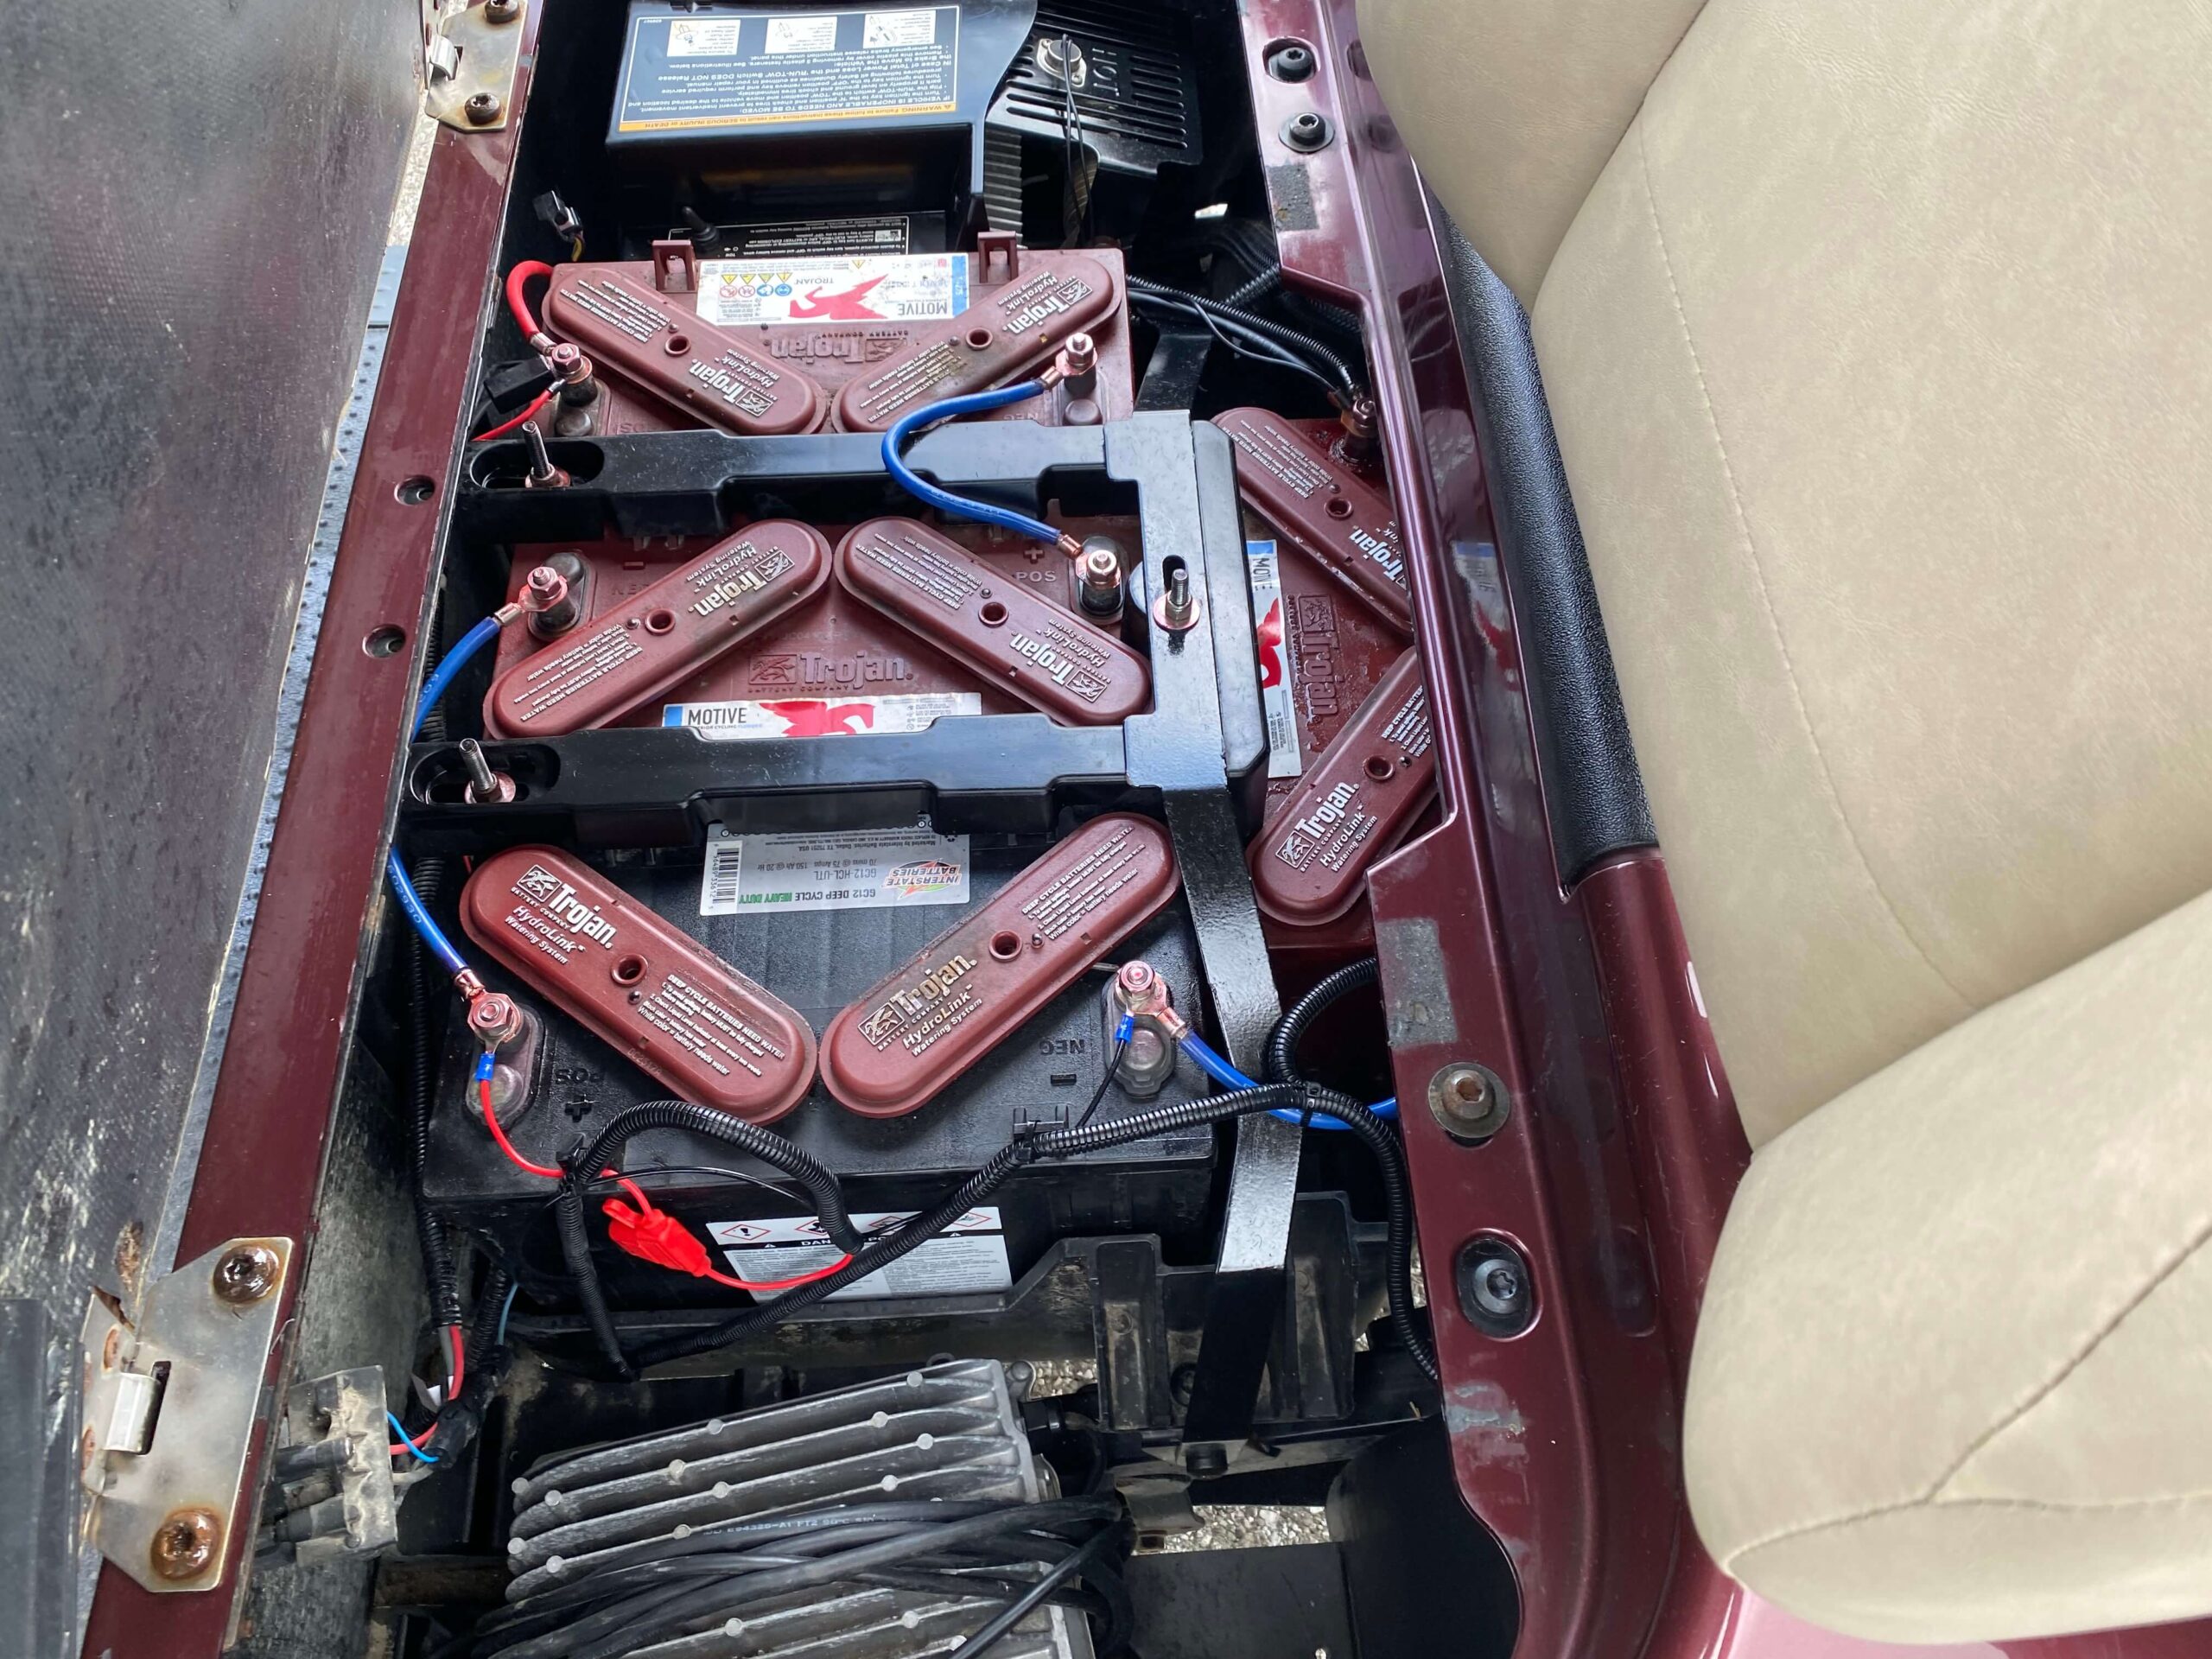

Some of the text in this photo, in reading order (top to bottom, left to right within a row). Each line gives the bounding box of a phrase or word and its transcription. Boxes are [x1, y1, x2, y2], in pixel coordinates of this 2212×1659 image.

[997, 270, 1050, 304] Watering System
[897, 301, 947, 315] MOTIVE
[1007, 289, 1069, 333] Trojan
[726, 348, 751, 364] System
[689, 361, 745, 403] Trojan
[686, 540, 750, 581] Watering System
[1348, 528, 1402, 581] Trojan
[693, 564, 766, 615] Trojan
[1015, 570, 1057, 582] POS
[625, 646, 643, 658] DEEP
[1009, 632, 1073, 684] Trojan
[1046, 617, 1111, 658] Watering System
[564, 670, 602, 694] BATTERIES
[799, 651, 905, 690] Trojan
[520, 704, 546, 720] WATER
[545, 692, 565, 705] NEED
[687, 708, 747, 725] MOTIVE
[1294, 782, 1355, 846] Trojan
[1331, 815, 1376, 871] Watering System
[813, 868, 876, 880] GC12-HCL-UTL
[886, 874, 958, 886] INTERSTATE
[892, 867, 956, 876] BATTERIES
[1021, 841, 1112, 913] DEEP CYCLE BATTERIES NEED
[543, 882, 616, 944] Trojan
[738, 888, 875, 903] GC12 DEEP CYCLE HEAVY DUTY
[505, 915, 569, 963] Watering System
[889, 955, 971, 1015] Trojan
[667, 974, 785, 1058] DEEP CYCLE BATTERIES NEED WATER
[877, 996, 943, 1050] BATTERY COMPANY
[911, 998, 982, 1055] Watering System
[1039, 1039, 1084, 1055] NEG
